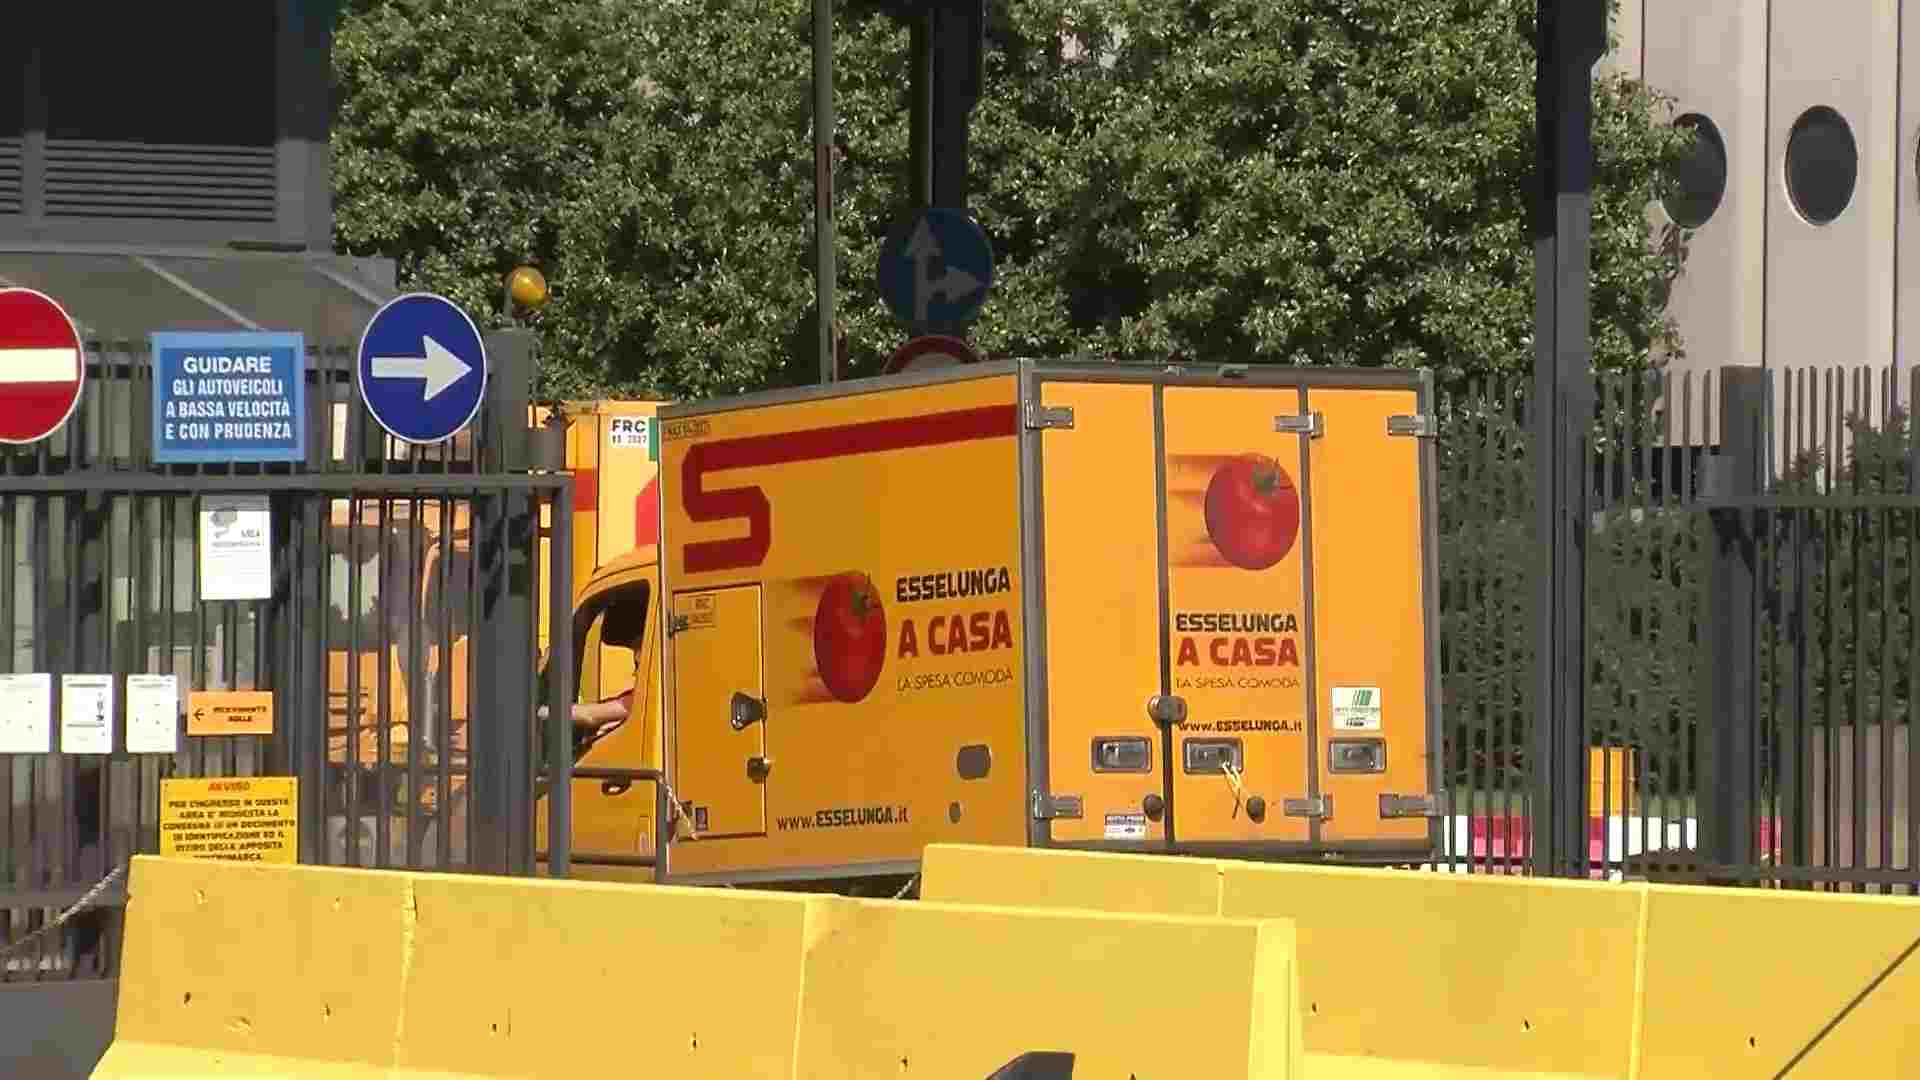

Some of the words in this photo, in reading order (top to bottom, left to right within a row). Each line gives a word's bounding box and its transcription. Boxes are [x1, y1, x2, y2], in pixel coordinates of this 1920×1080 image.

[182, 355, 273, 374] GUIDARE
[172, 379, 194, 396] GLI
[197, 379, 283, 396] AUTOVEICOLI
[165, 401, 177, 418] A
[178, 401, 225, 418] BASSA
[227, 397, 291, 417] VELOCITÀ
[164, 423, 176, 440] E
[178, 423, 209, 440] CON
[213, 422, 292, 440] PRUDENZA
[612, 419, 646, 433] FRC
[896, 566, 1011, 603] ESSELUNGA
[1175, 612, 1298, 633] ESSELUNGA
[898, 618, 919, 660] A
[928, 609, 1013, 656] CASA
[1177, 637, 1200, 667] A
[1209, 637, 1299, 667] CASA
[897, 676, 911, 692] LA
[914, 673, 952, 690] SPESA
[953, 668, 1014, 688] COMODA
[1176, 679, 1191, 689] LA
[1195, 678, 1233, 689] SPESA
[1238, 678, 1300, 689] COMODA
[1178, 719, 1302, 733] www.ESSELUNGA.it
[776, 806, 908, 832] www.ESSELUNGA.it
